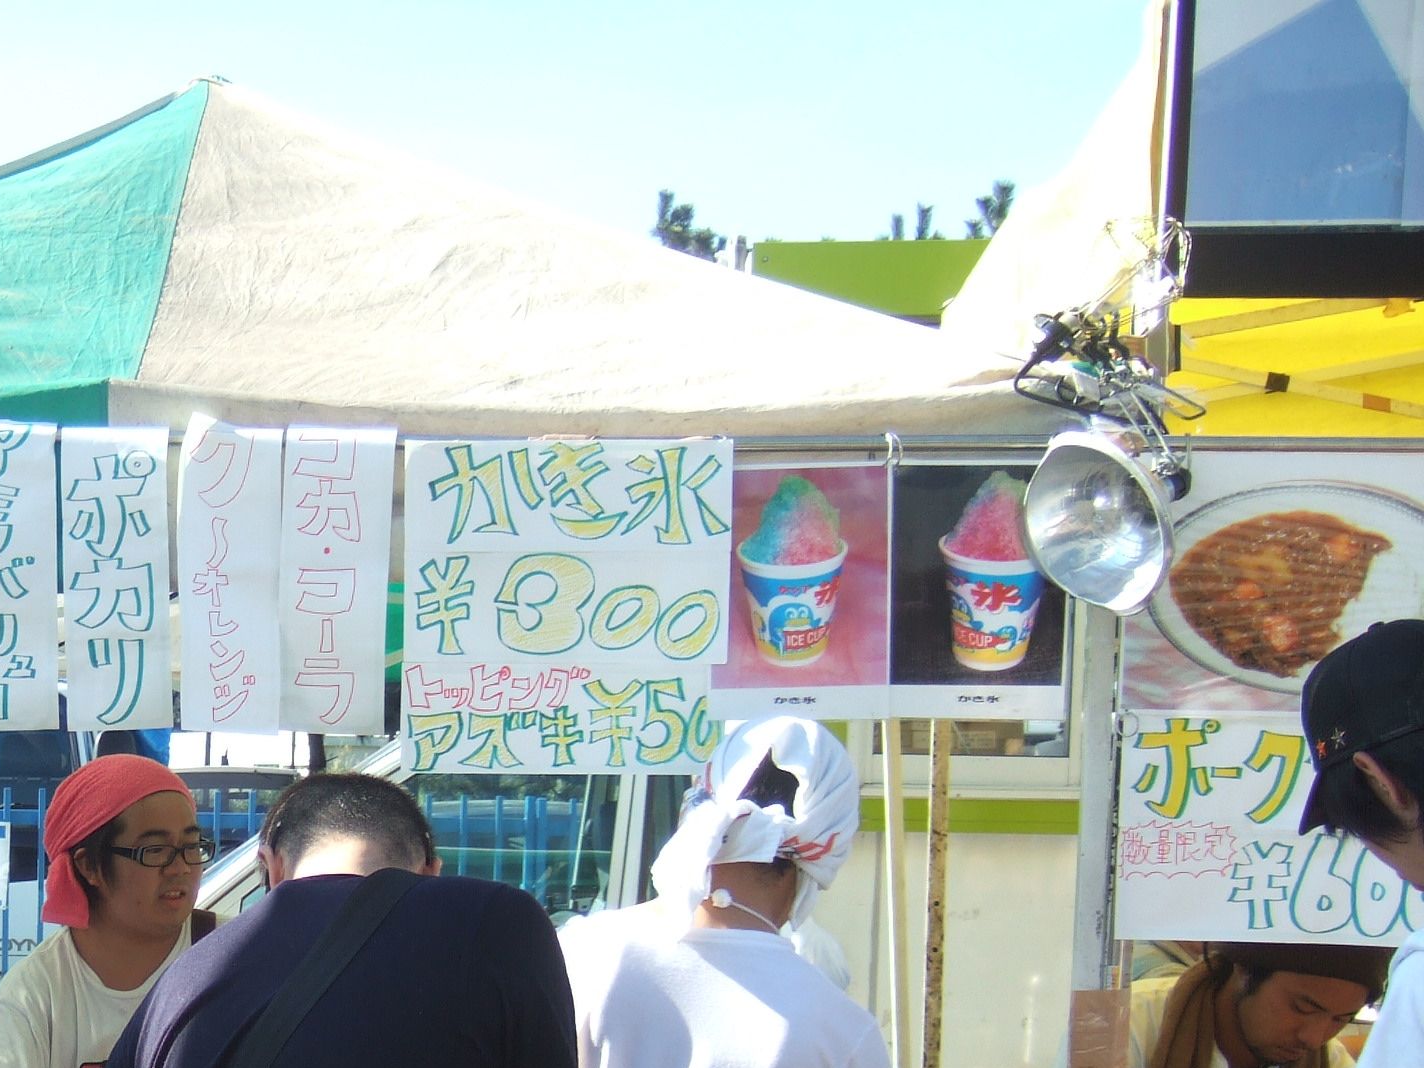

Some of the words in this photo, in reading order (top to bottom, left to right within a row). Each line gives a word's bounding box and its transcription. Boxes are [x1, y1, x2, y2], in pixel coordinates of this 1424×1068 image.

[429, 442, 731, 545] かき氷
[67, 450, 156, 726] ポカリ
[292, 432, 362, 726] コカ・コーラ
[415, 552, 721, 661] ¥300
[404, 664, 592, 713] トッピング
[968, 631, 993, 648] CUP
[773, 696, 817, 705] かき氷
[957, 695, 1000, 704] かき氷
[1131, 717, 1311, 824] ポーク
